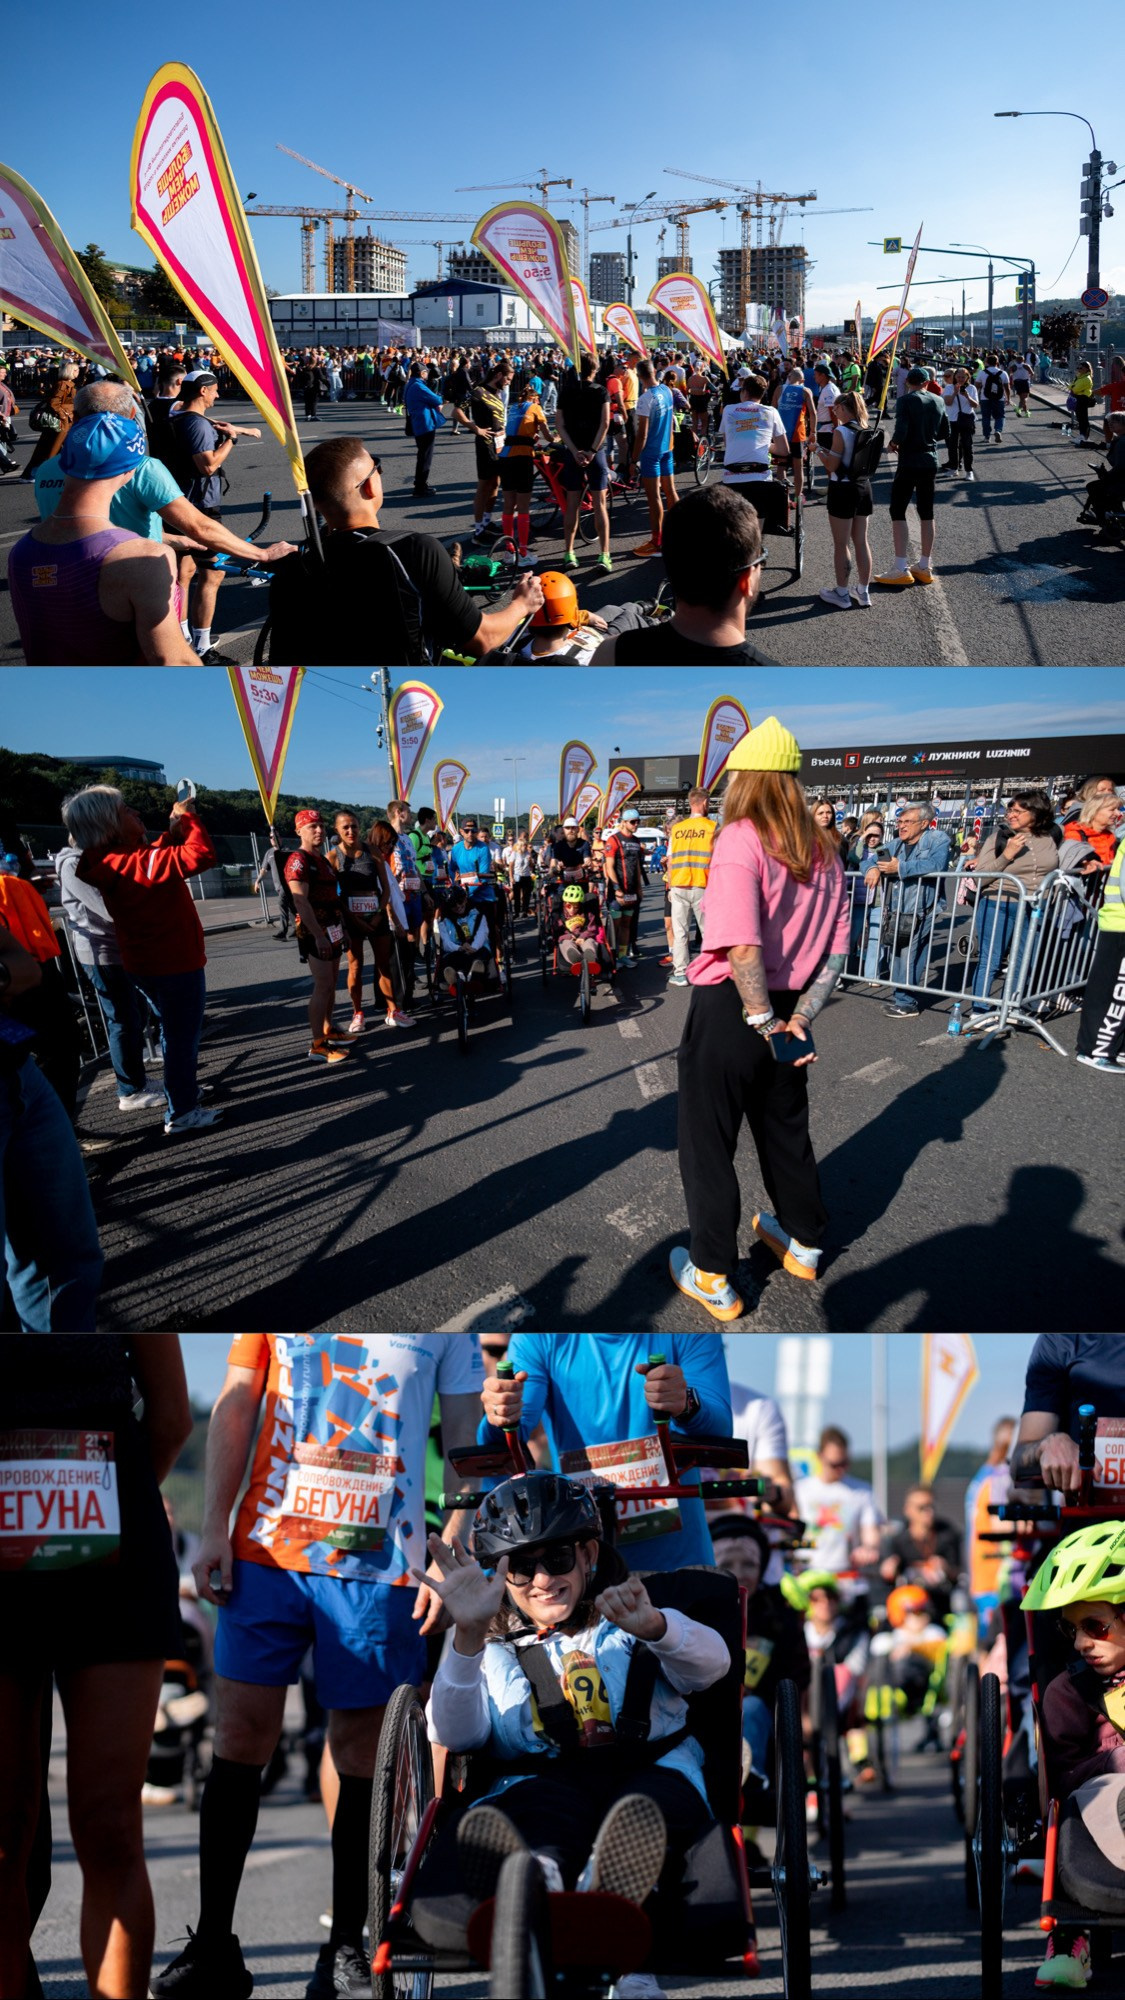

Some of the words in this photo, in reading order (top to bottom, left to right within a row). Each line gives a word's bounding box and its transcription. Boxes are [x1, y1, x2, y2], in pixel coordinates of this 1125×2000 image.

[250, 684, 280, 704] 5:30
[401, 736, 419, 745] 5:50
[811, 757, 842, 767] Въезд
[848, 756, 855, 765] 5
[863, 754, 907, 764] Entrance
[928, 751, 981, 761] ЛУЖНИКИ
[986, 748, 1031, 759] LUZHNIKI
[675, 829, 706, 840] СУДЬЯ
[352, 901, 377, 913] БЕГУНА
[1092, 1002, 1125, 1057] NIKE
[646, 1448, 662, 1460] КМ
[297, 1471, 384, 1493] СОПРОВОЖДЕНИЕ
[248, 1454, 291, 1547] RUN
[293, 1486, 379, 1524] БЕГУНА
